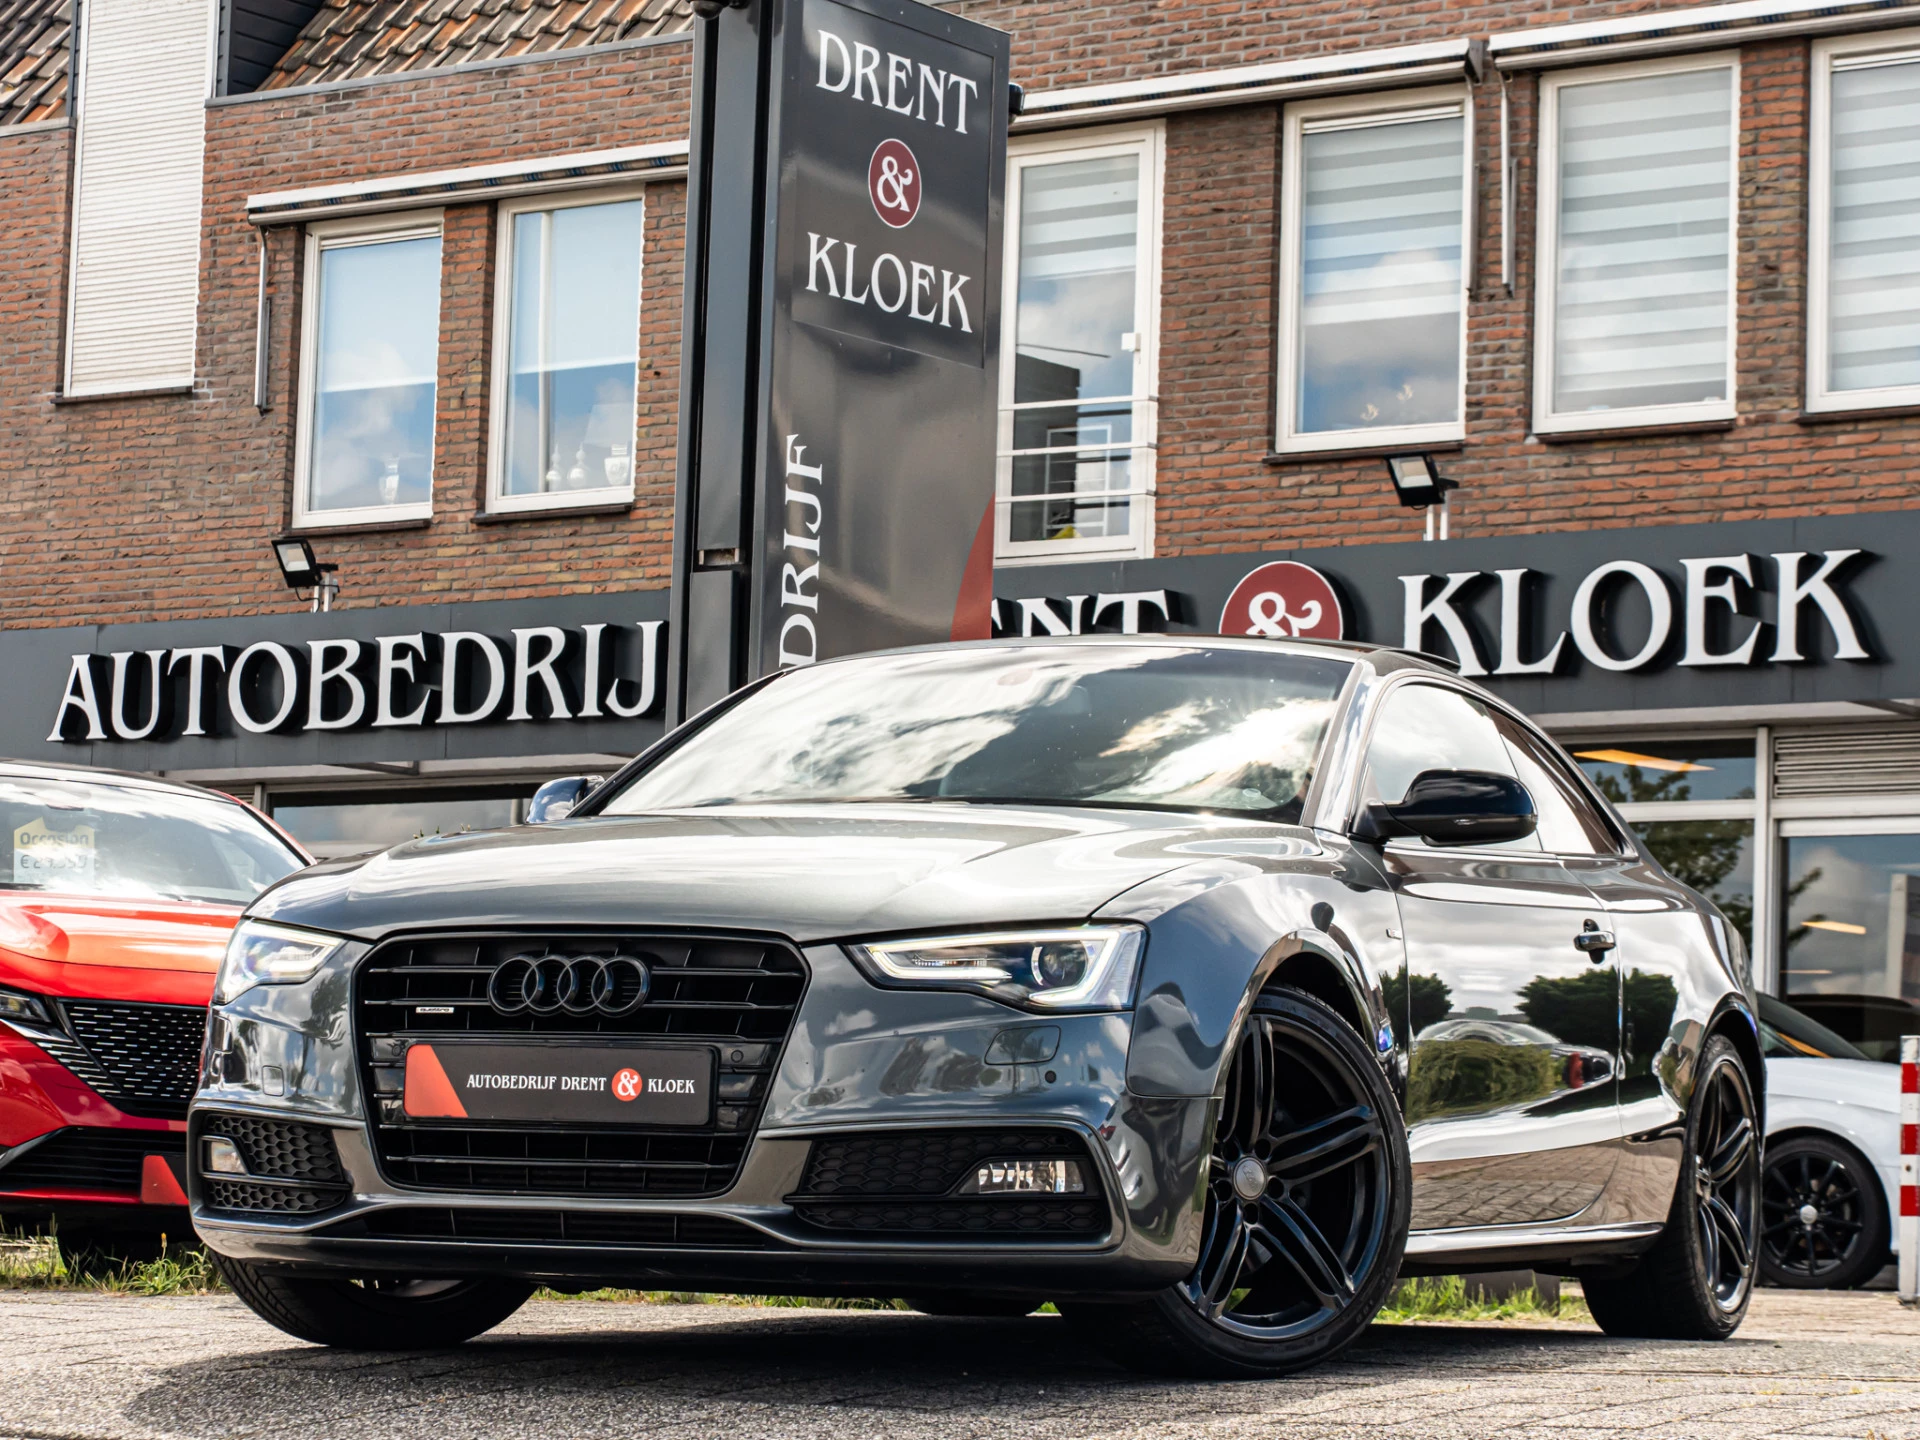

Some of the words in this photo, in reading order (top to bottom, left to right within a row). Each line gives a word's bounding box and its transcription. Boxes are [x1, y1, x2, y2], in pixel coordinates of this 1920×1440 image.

[816, 29, 979, 135] DRENT
[877, 155, 914, 213] &
[805, 231, 974, 334] KLOEK
[1397, 549, 1871, 677] KLOEK
[466, 1074, 557, 1091] AUTOBEDRIJF
[561, 1076, 607, 1092] DRENT
[617, 1071, 639, 1097] &
[647, 1078, 696, 1094] KLOEK
